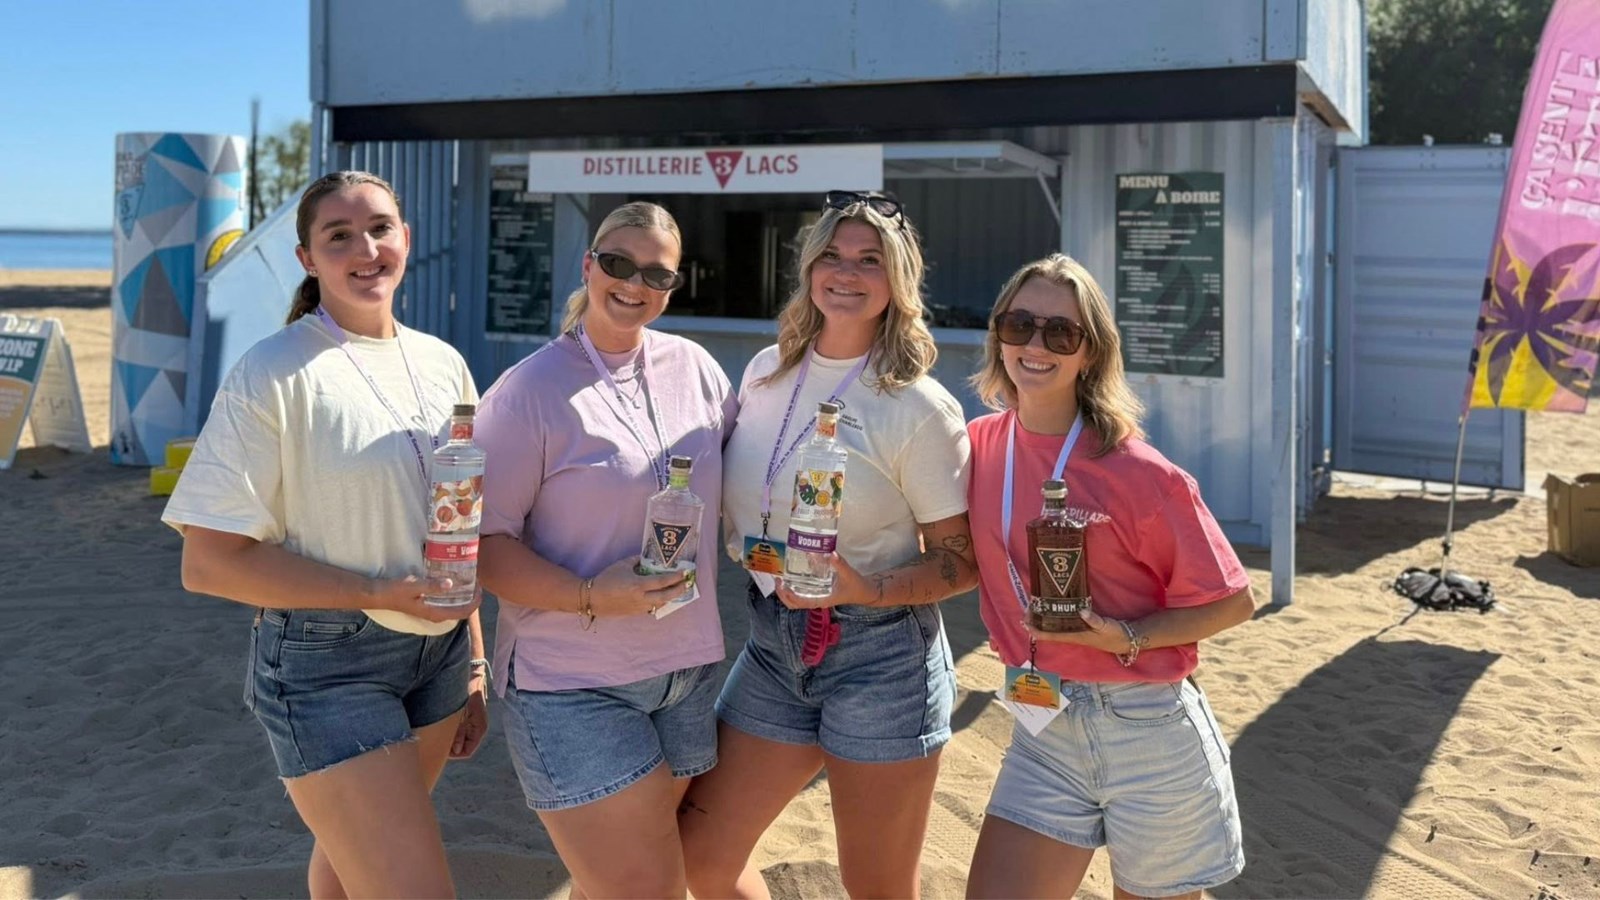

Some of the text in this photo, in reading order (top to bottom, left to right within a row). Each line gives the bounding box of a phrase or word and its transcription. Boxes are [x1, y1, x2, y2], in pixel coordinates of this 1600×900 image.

[583, 155, 799, 176] DISTILLERIE 3 LACS
[1119, 175, 1169, 188] MENU
[1170, 191, 1220, 204] BOIRE
[662, 530, 677, 546] 3
[798, 535, 822, 549] VODKA
[1053, 556, 1069, 572] 3
[1052, 603, 1077, 612] RHUM
